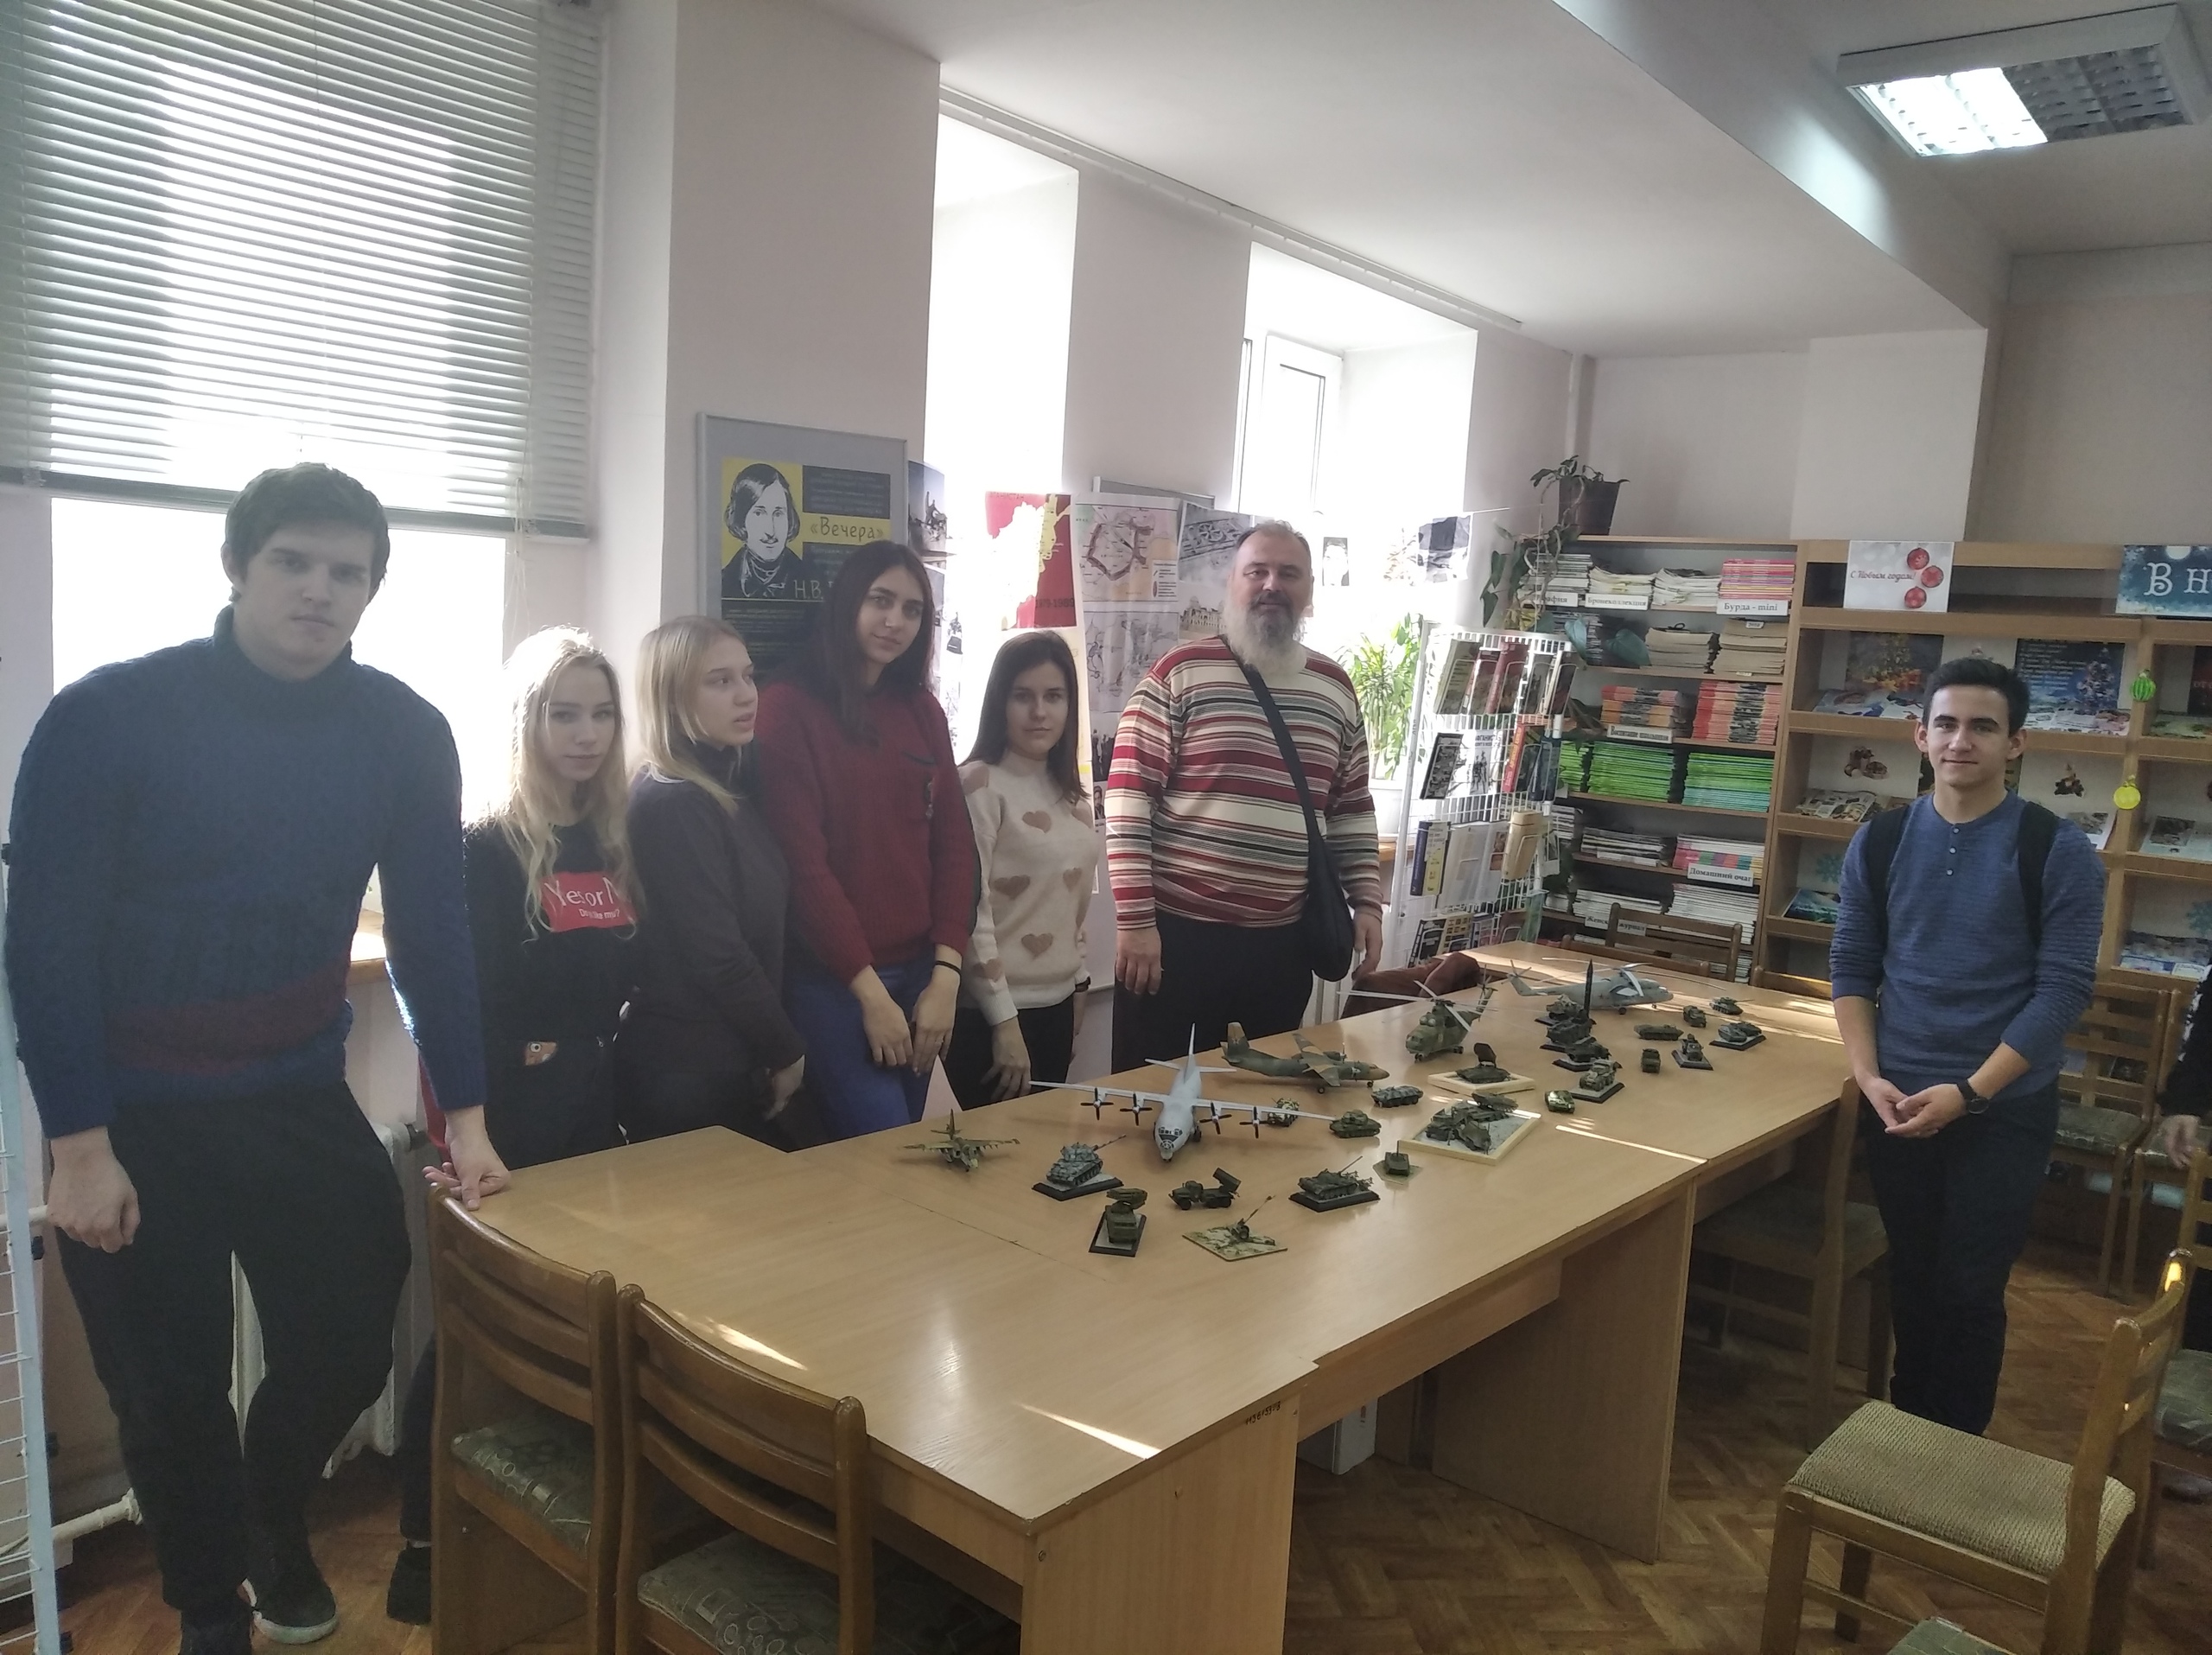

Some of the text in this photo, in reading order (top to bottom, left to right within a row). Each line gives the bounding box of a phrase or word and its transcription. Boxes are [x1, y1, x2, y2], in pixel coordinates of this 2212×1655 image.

[810, 516, 884, 542] «Вечера»
[1858, 570, 1885, 580] Новым
[2143, 562, 2173, 596] В
[1724, 602, 1751, 613] Бурда
[1758, 603, 1778, 612] mini
[1689, 867, 1752, 882] Домашний очаг
[1586, 915, 1609, 925] Женск
